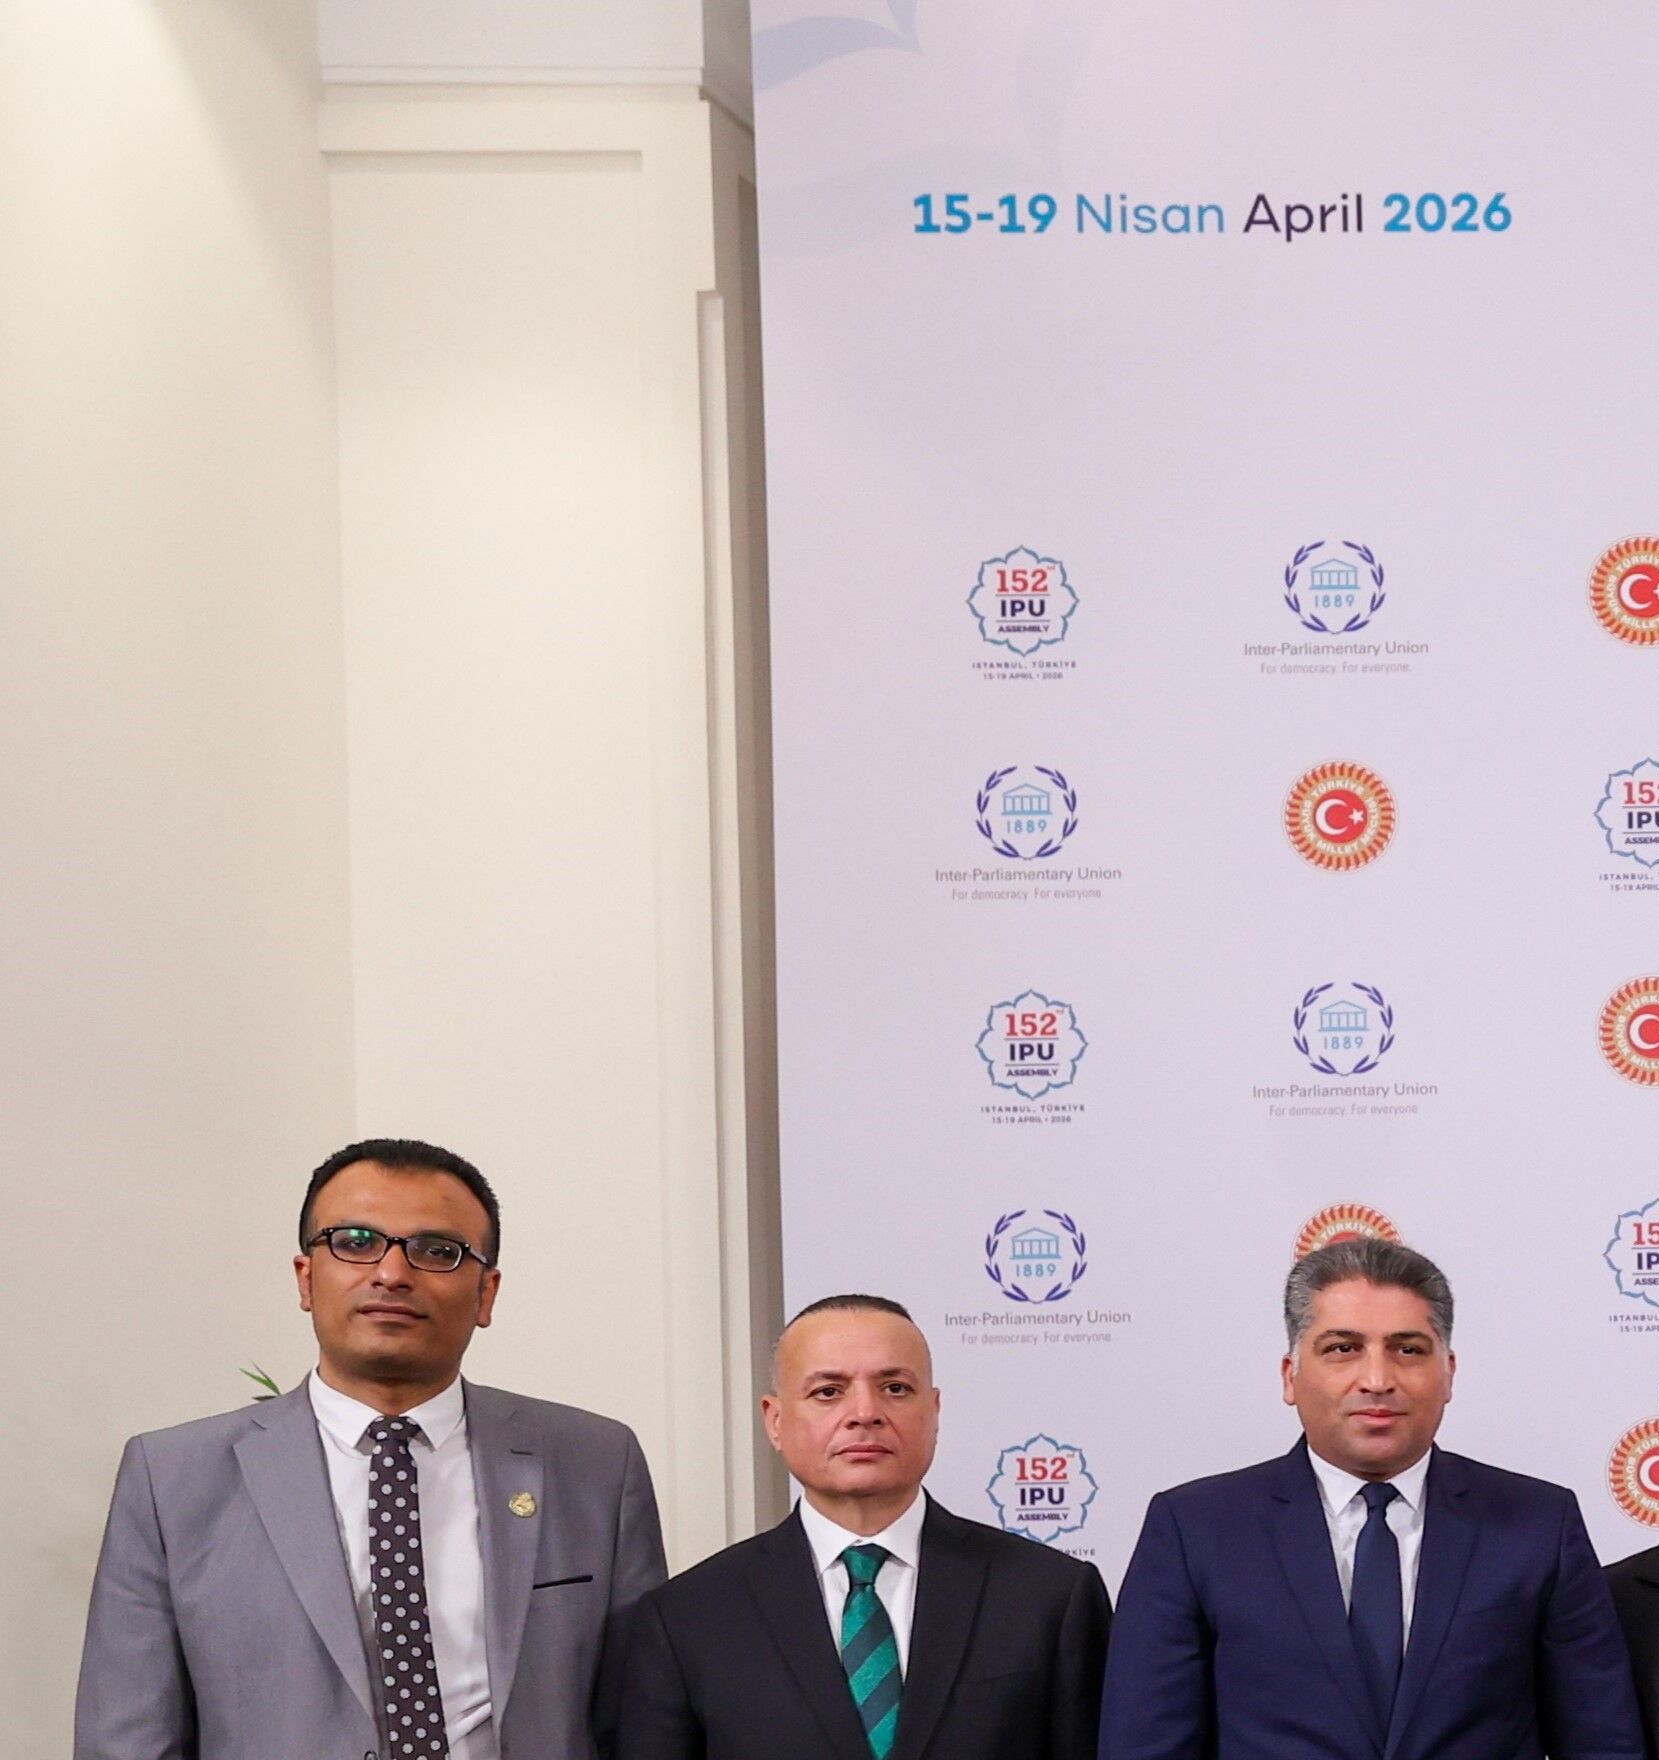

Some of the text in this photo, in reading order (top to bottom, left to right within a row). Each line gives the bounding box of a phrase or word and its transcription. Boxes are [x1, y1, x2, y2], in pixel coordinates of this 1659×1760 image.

[912, 192, 1513, 242] 15-19 Nisan April 2026
[995, 569, 1049, 595] 152
[1001, 599, 1045, 617] IPU
[1315, 594, 1355, 608] 1889
[998, 625, 1049, 633] ASSEMBLY
[1244, 640, 1429, 656] Inter-Parliamentary Union
[1310, 778, 1364, 798] TÜRKİYE
[1007, 819, 1047, 834] 1889
[935, 867, 1122, 882] Inter-Parliamentary Union
[1004, 1013, 1058, 1039] 152
[1324, 1036, 1364, 1050] 1889
[1010, 1043, 1054, 1061] IPU
[1007, 1069, 1058, 1077] ASSEMBLY
[1253, 1082, 1438, 1099] Inter-Parliamentary Union
[1016, 1263, 1056, 1278] 1889
[945, 1310, 1131, 1326] Inter-Parliamentary Union
[1014, 1457, 1068, 1483] 152
[1020, 1487, 1064, 1506] IPU
[1017, 1513, 1068, 1521] ASSEMBLY
